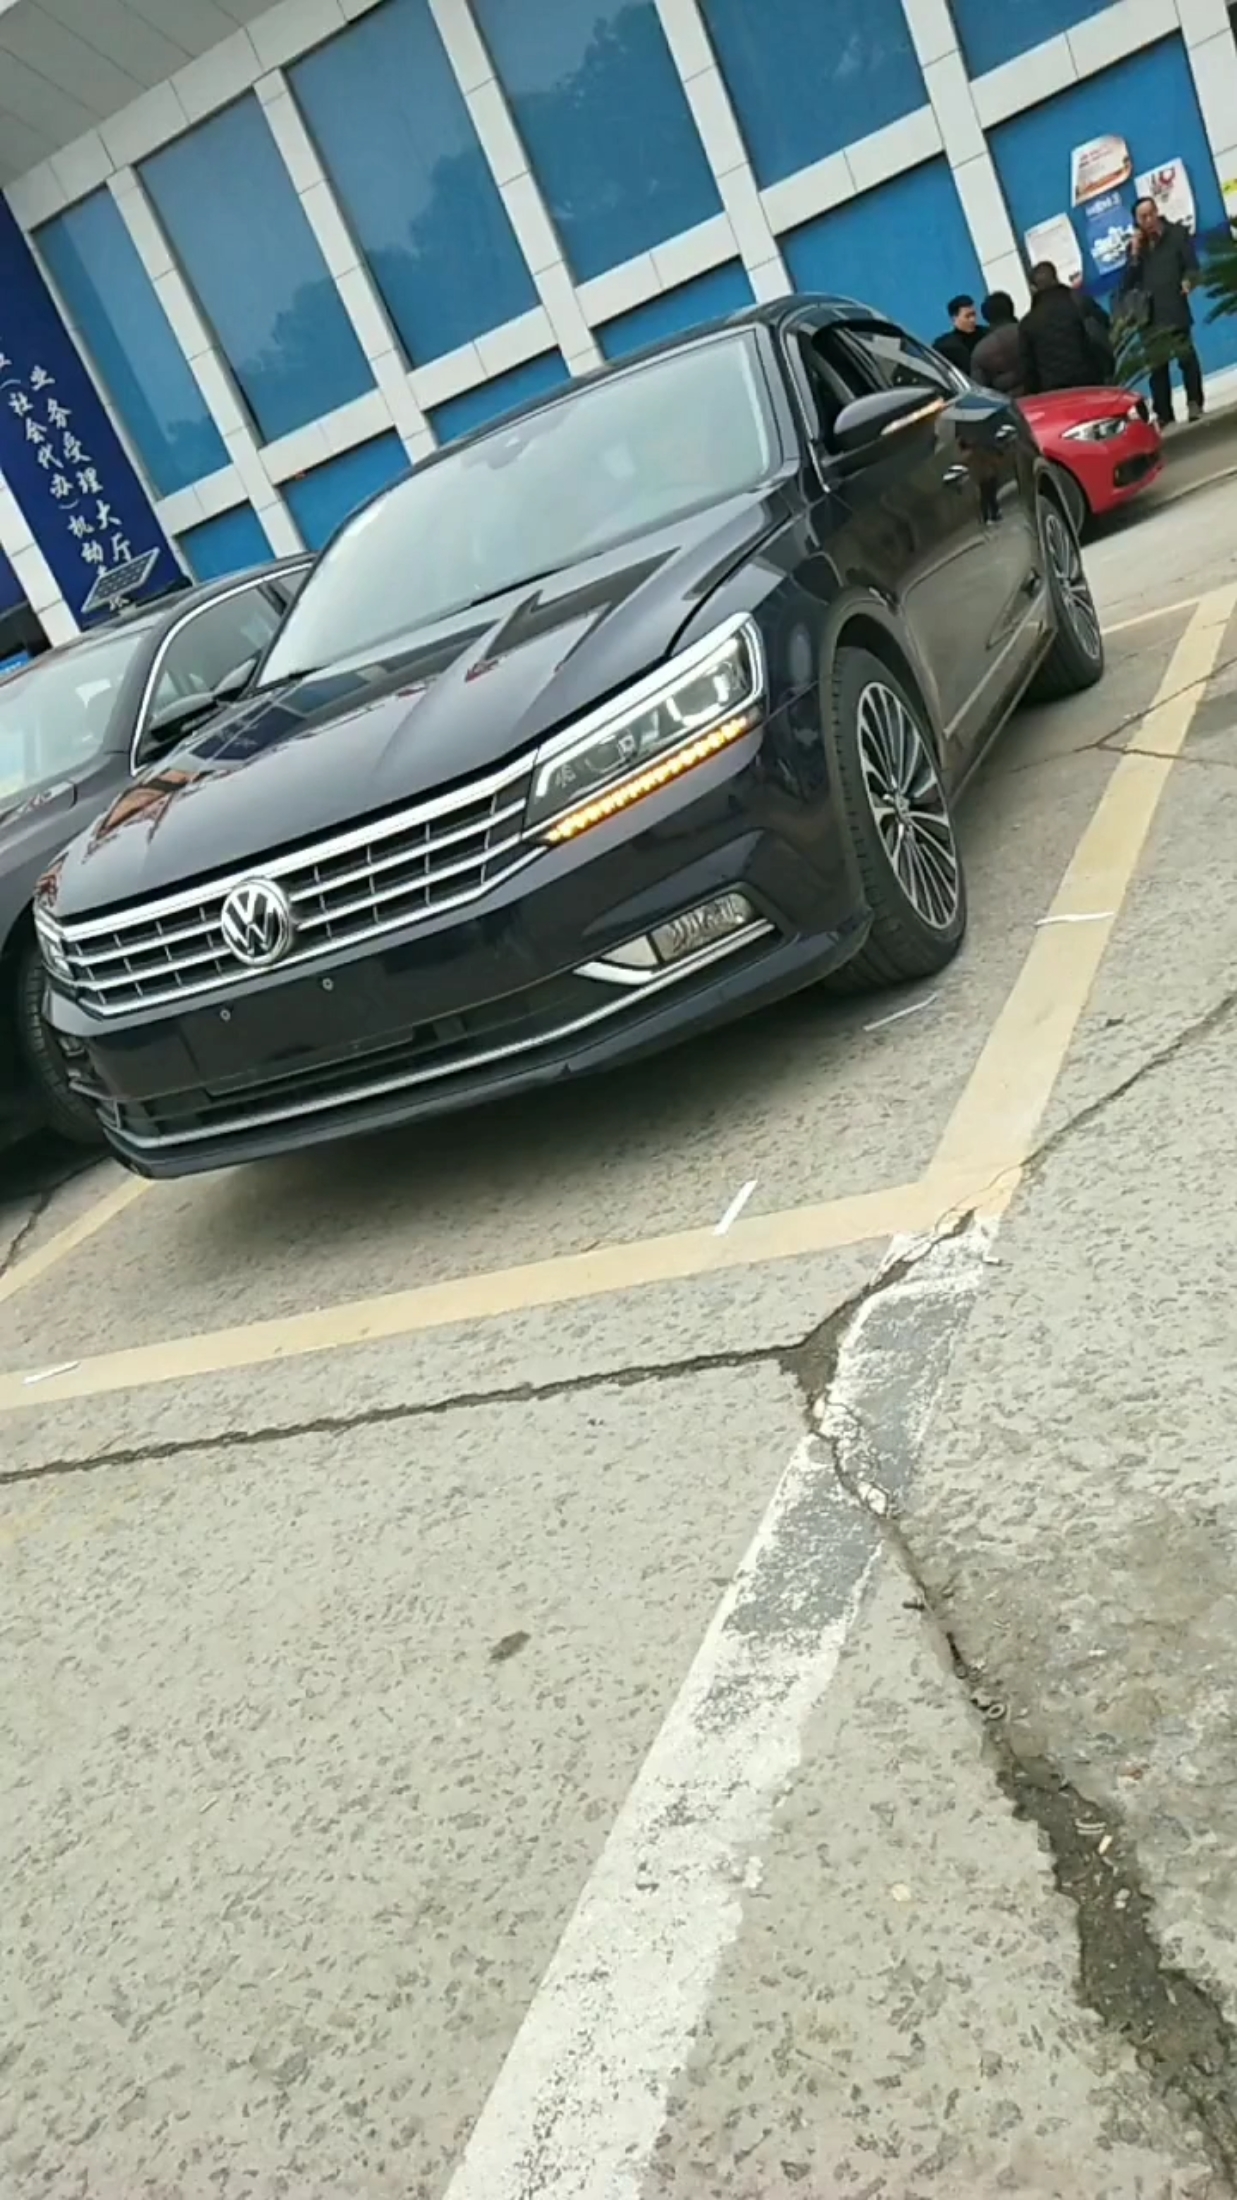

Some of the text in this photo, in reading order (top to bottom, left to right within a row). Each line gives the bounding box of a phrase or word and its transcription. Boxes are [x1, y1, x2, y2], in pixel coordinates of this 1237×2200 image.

[30, 365, 132, 564] 业务受理大厅
[223, 880, 285, 962] VW
